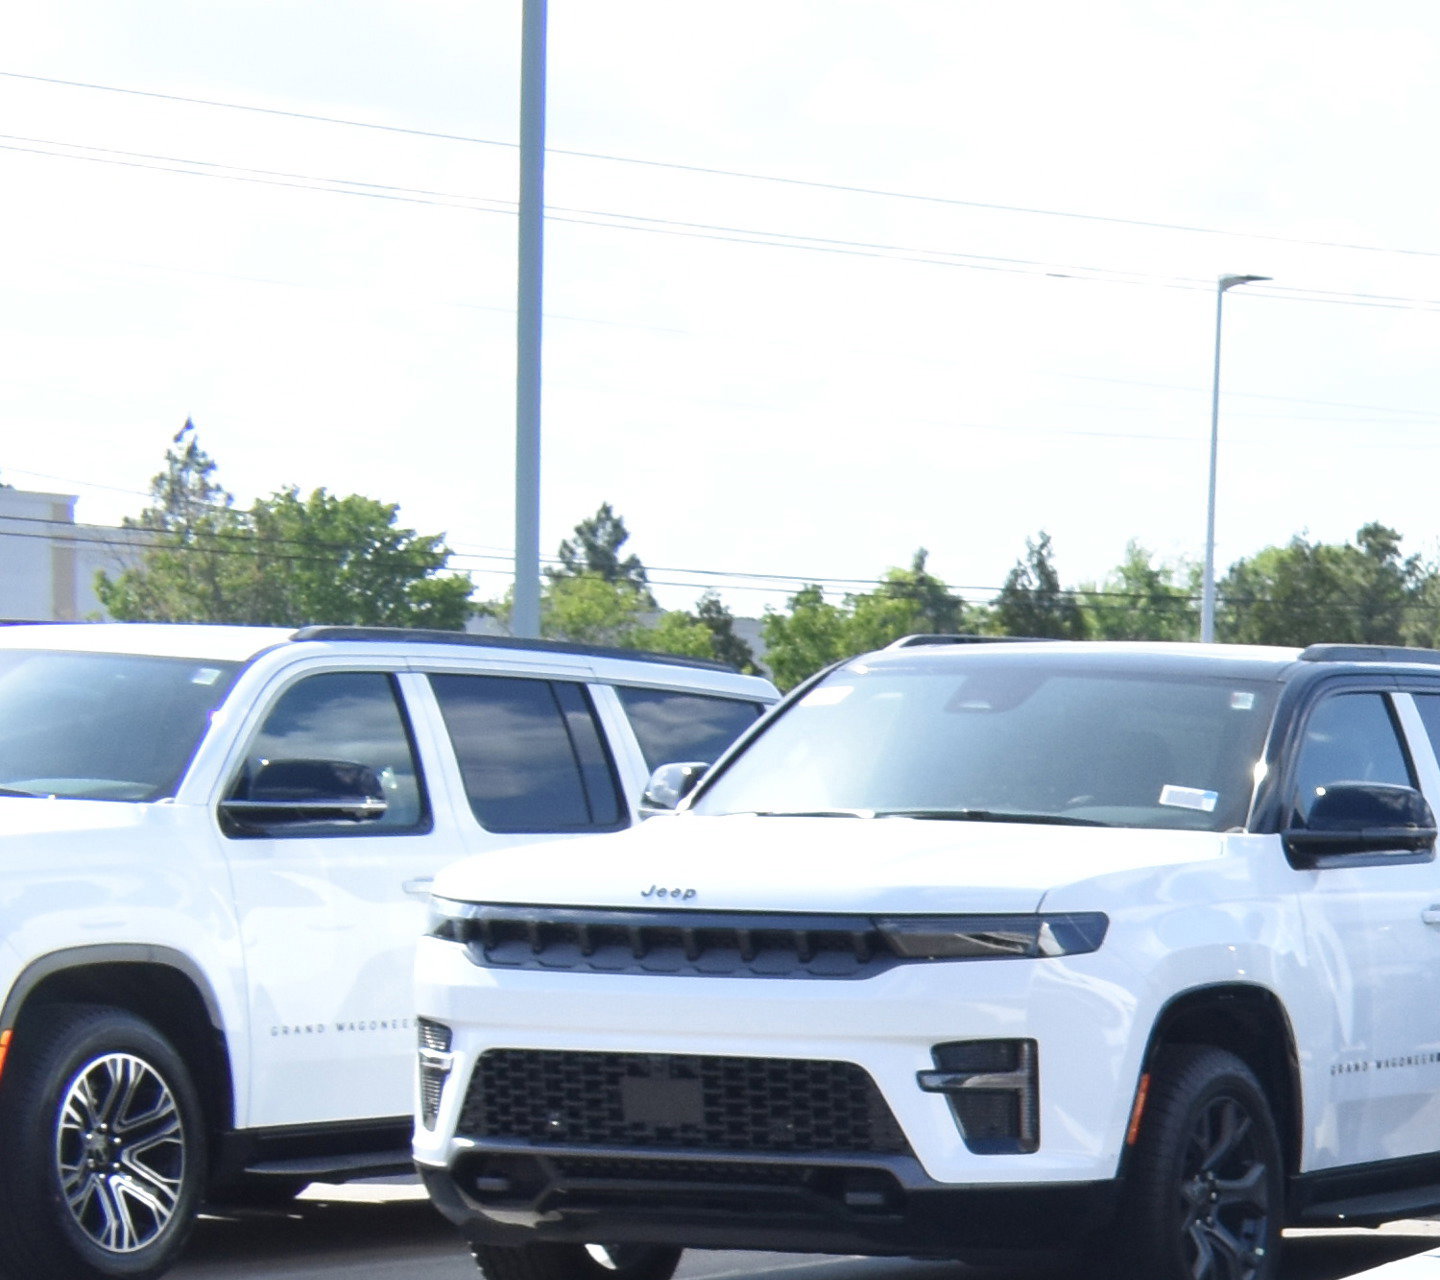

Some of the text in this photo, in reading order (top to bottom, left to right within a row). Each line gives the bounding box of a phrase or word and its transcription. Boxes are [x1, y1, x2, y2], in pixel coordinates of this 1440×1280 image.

[641, 885, 697, 901] Jeep
[270, 1024, 326, 1037] GRAND
[1330, 1061, 1369, 1076] GRAND
